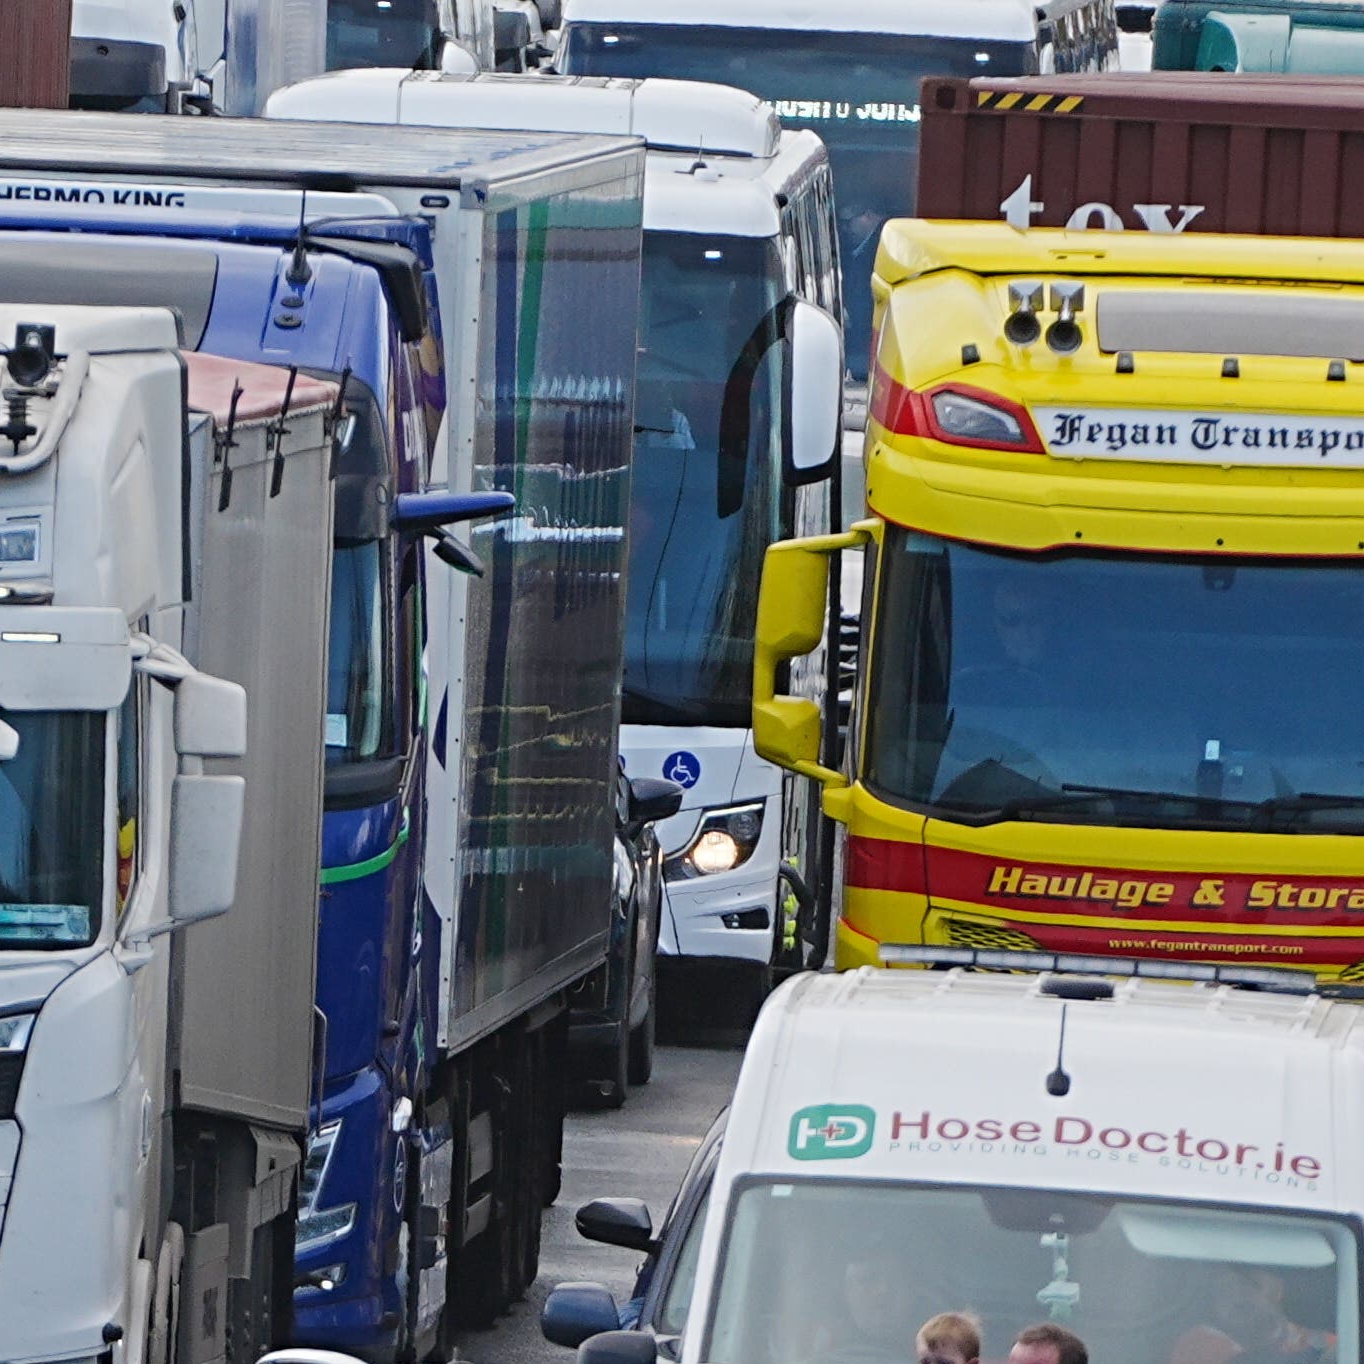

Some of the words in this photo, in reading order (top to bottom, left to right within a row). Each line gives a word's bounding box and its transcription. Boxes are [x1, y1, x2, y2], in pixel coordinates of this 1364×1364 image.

[1049, 412, 1177, 451] Fegan
[988, 866, 1175, 909] Haulage
[1190, 878, 1226, 907] &
[1108, 937, 1305, 956] www.fegantransport.com
[888, 1142, 1048, 1157] PROVIDING
[1067, 1147, 1140, 1164] HOSE
[1158, 1155, 1319, 1193] SOLUTIONS
